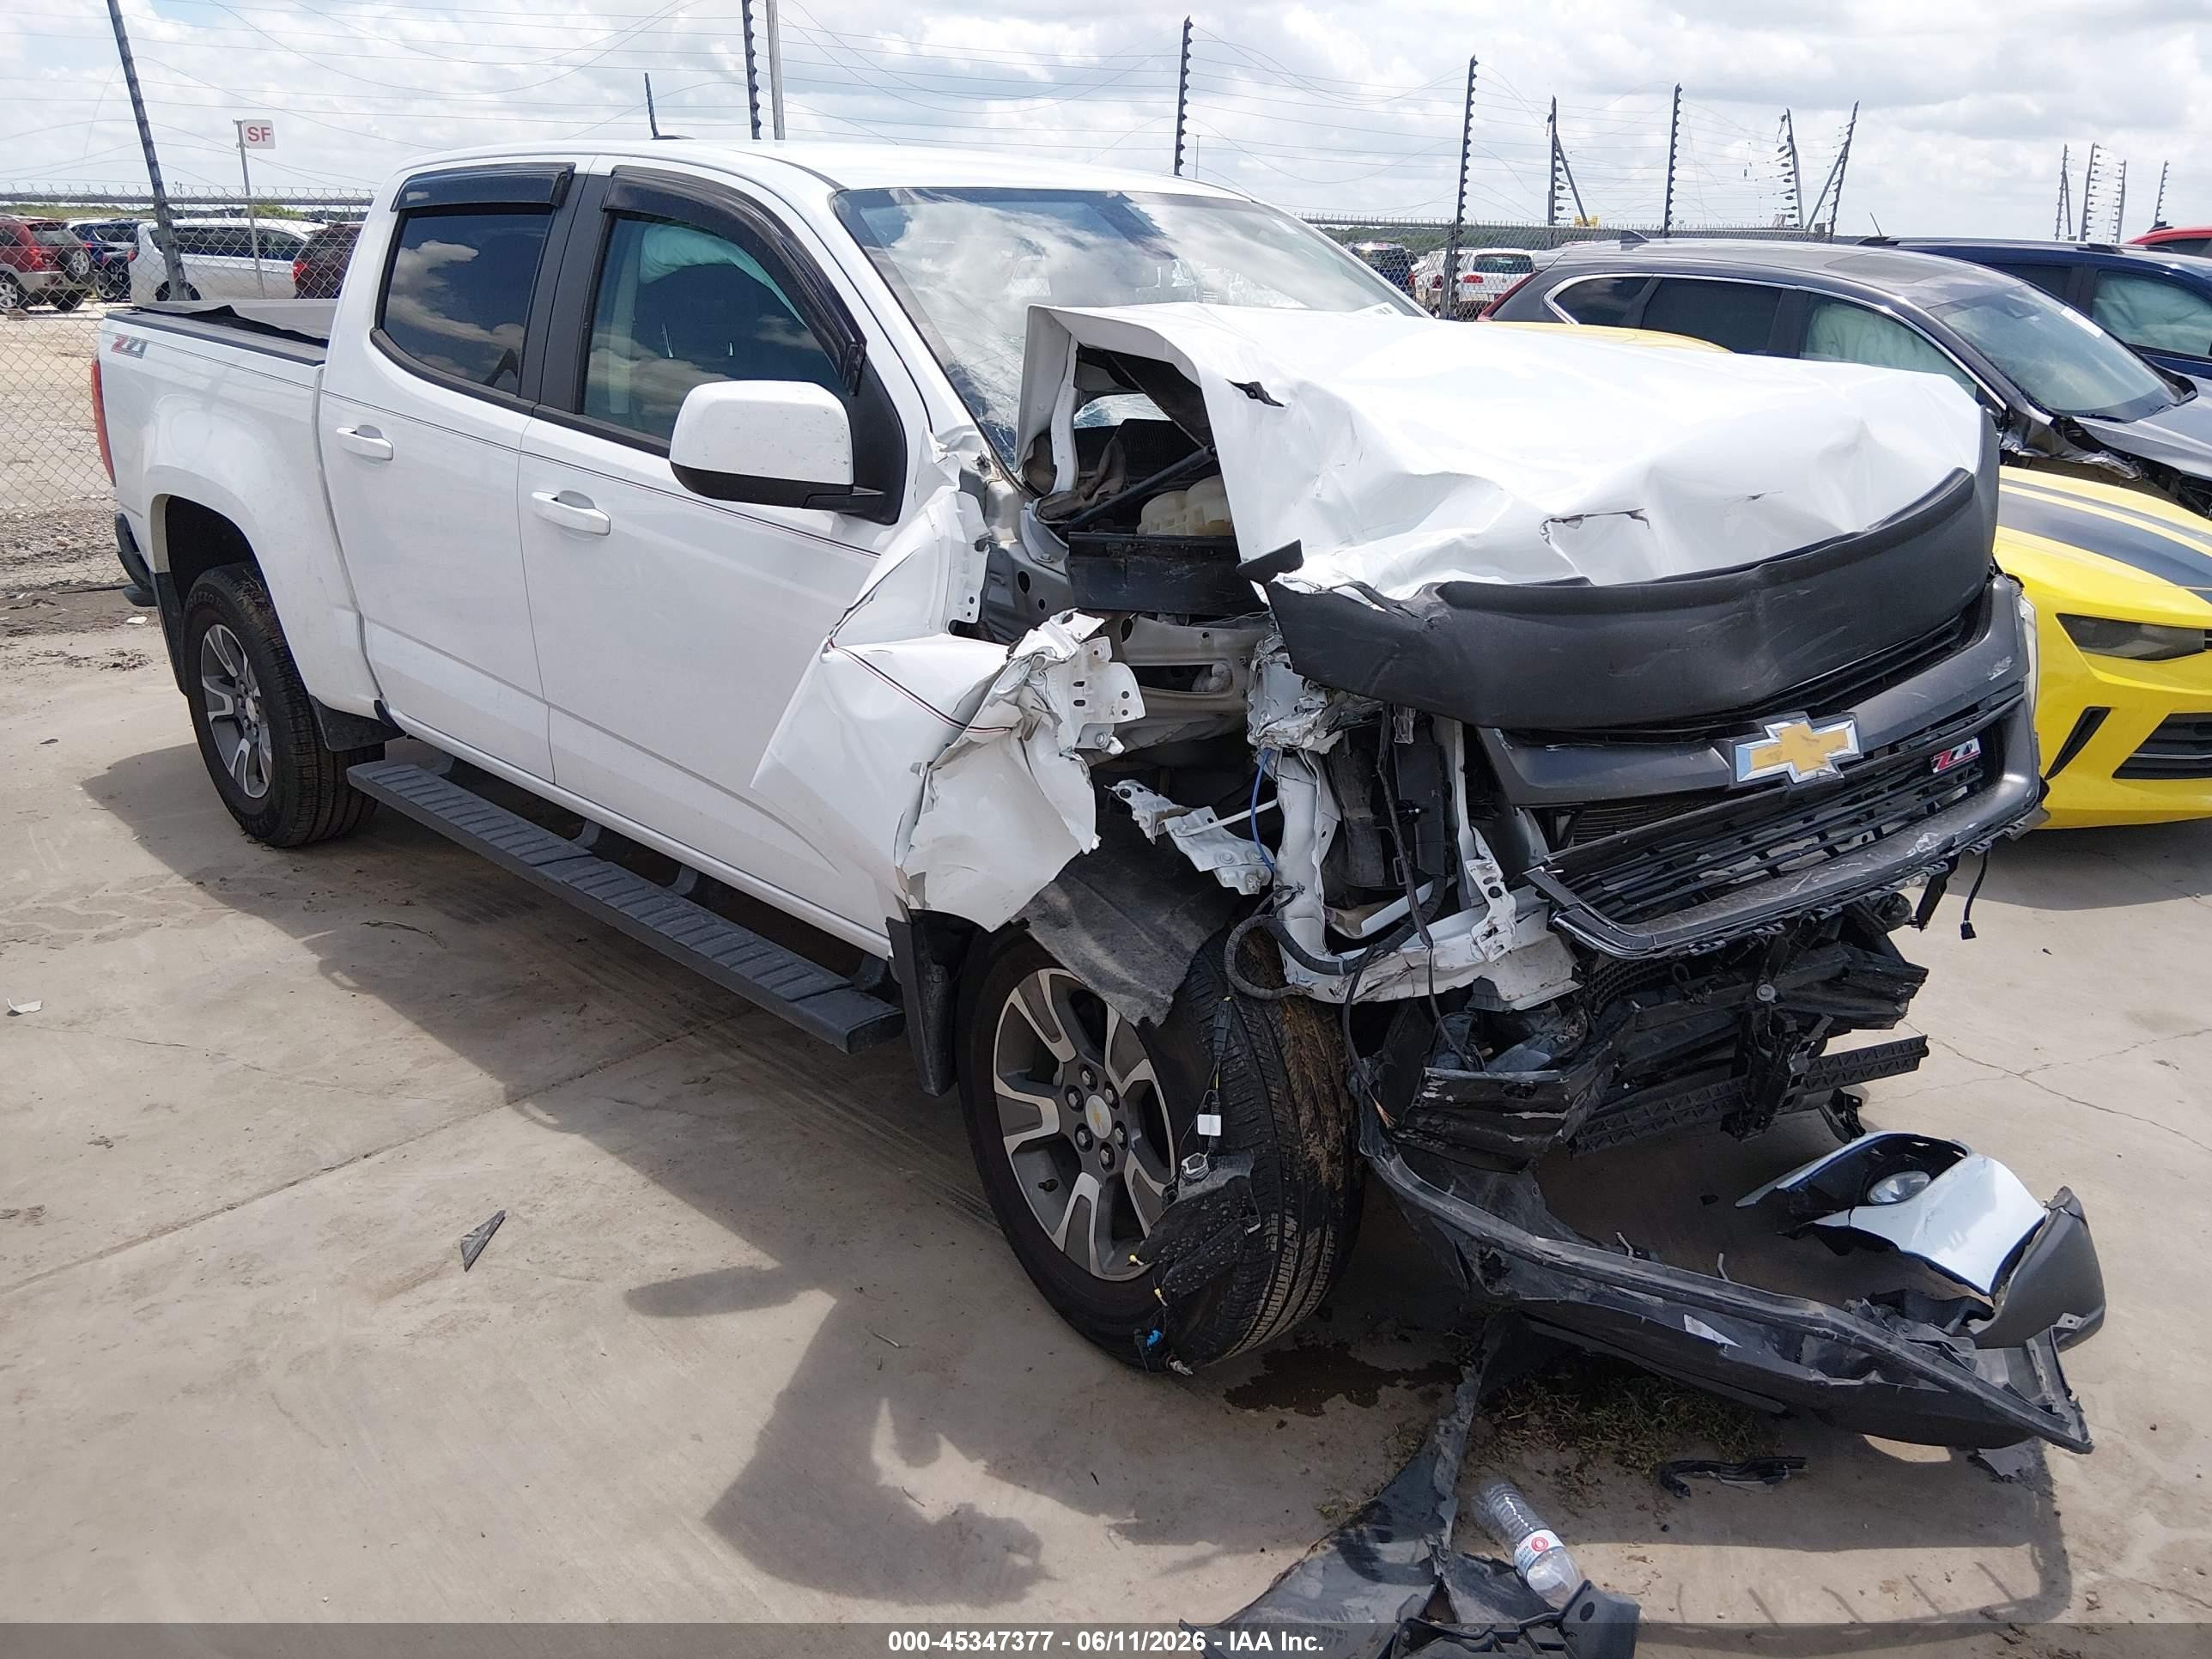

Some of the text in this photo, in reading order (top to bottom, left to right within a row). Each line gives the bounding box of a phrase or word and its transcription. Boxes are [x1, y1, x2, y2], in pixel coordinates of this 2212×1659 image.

[246, 126, 271, 142] SF
[110, 334, 148, 359] Z71
[1930, 737, 1981, 774] Z71
